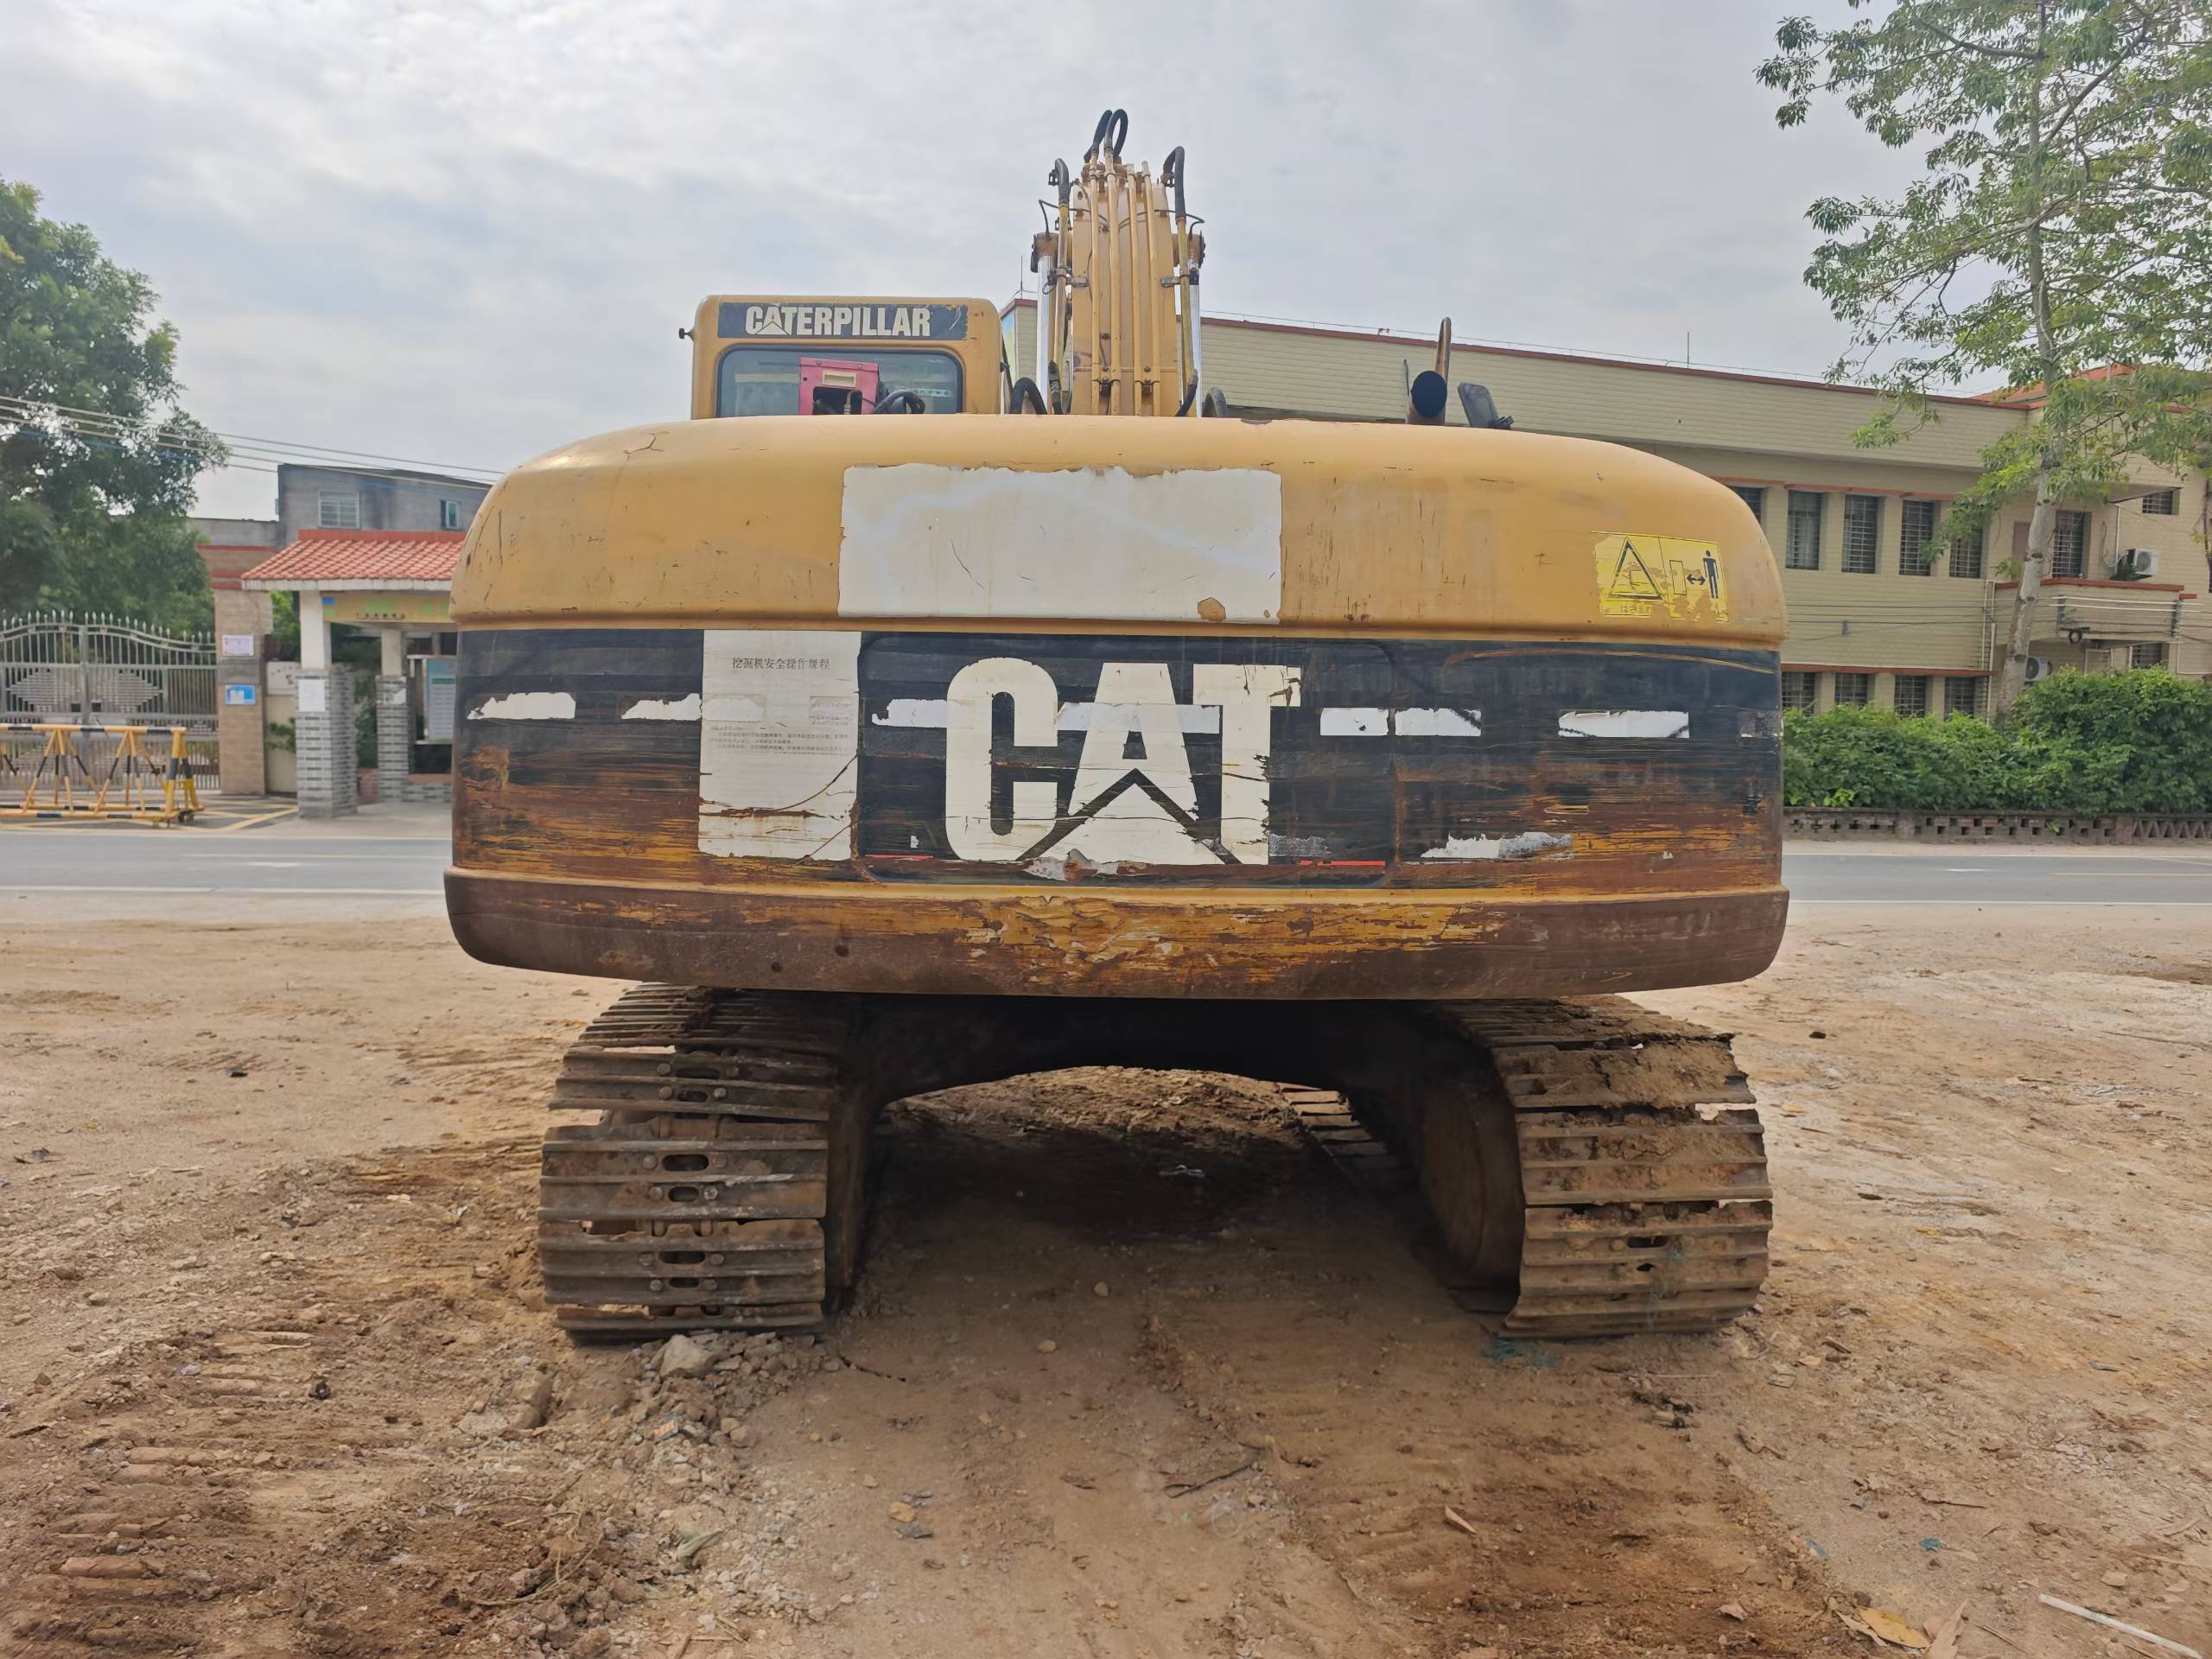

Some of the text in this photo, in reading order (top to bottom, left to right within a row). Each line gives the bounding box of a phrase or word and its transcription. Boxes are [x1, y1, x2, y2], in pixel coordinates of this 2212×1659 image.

[745, 305, 931, 337] CATERPILLAR
[732, 657, 830, 670] 挖掘机安全操作规程
[945, 657, 1301, 866] CAT
